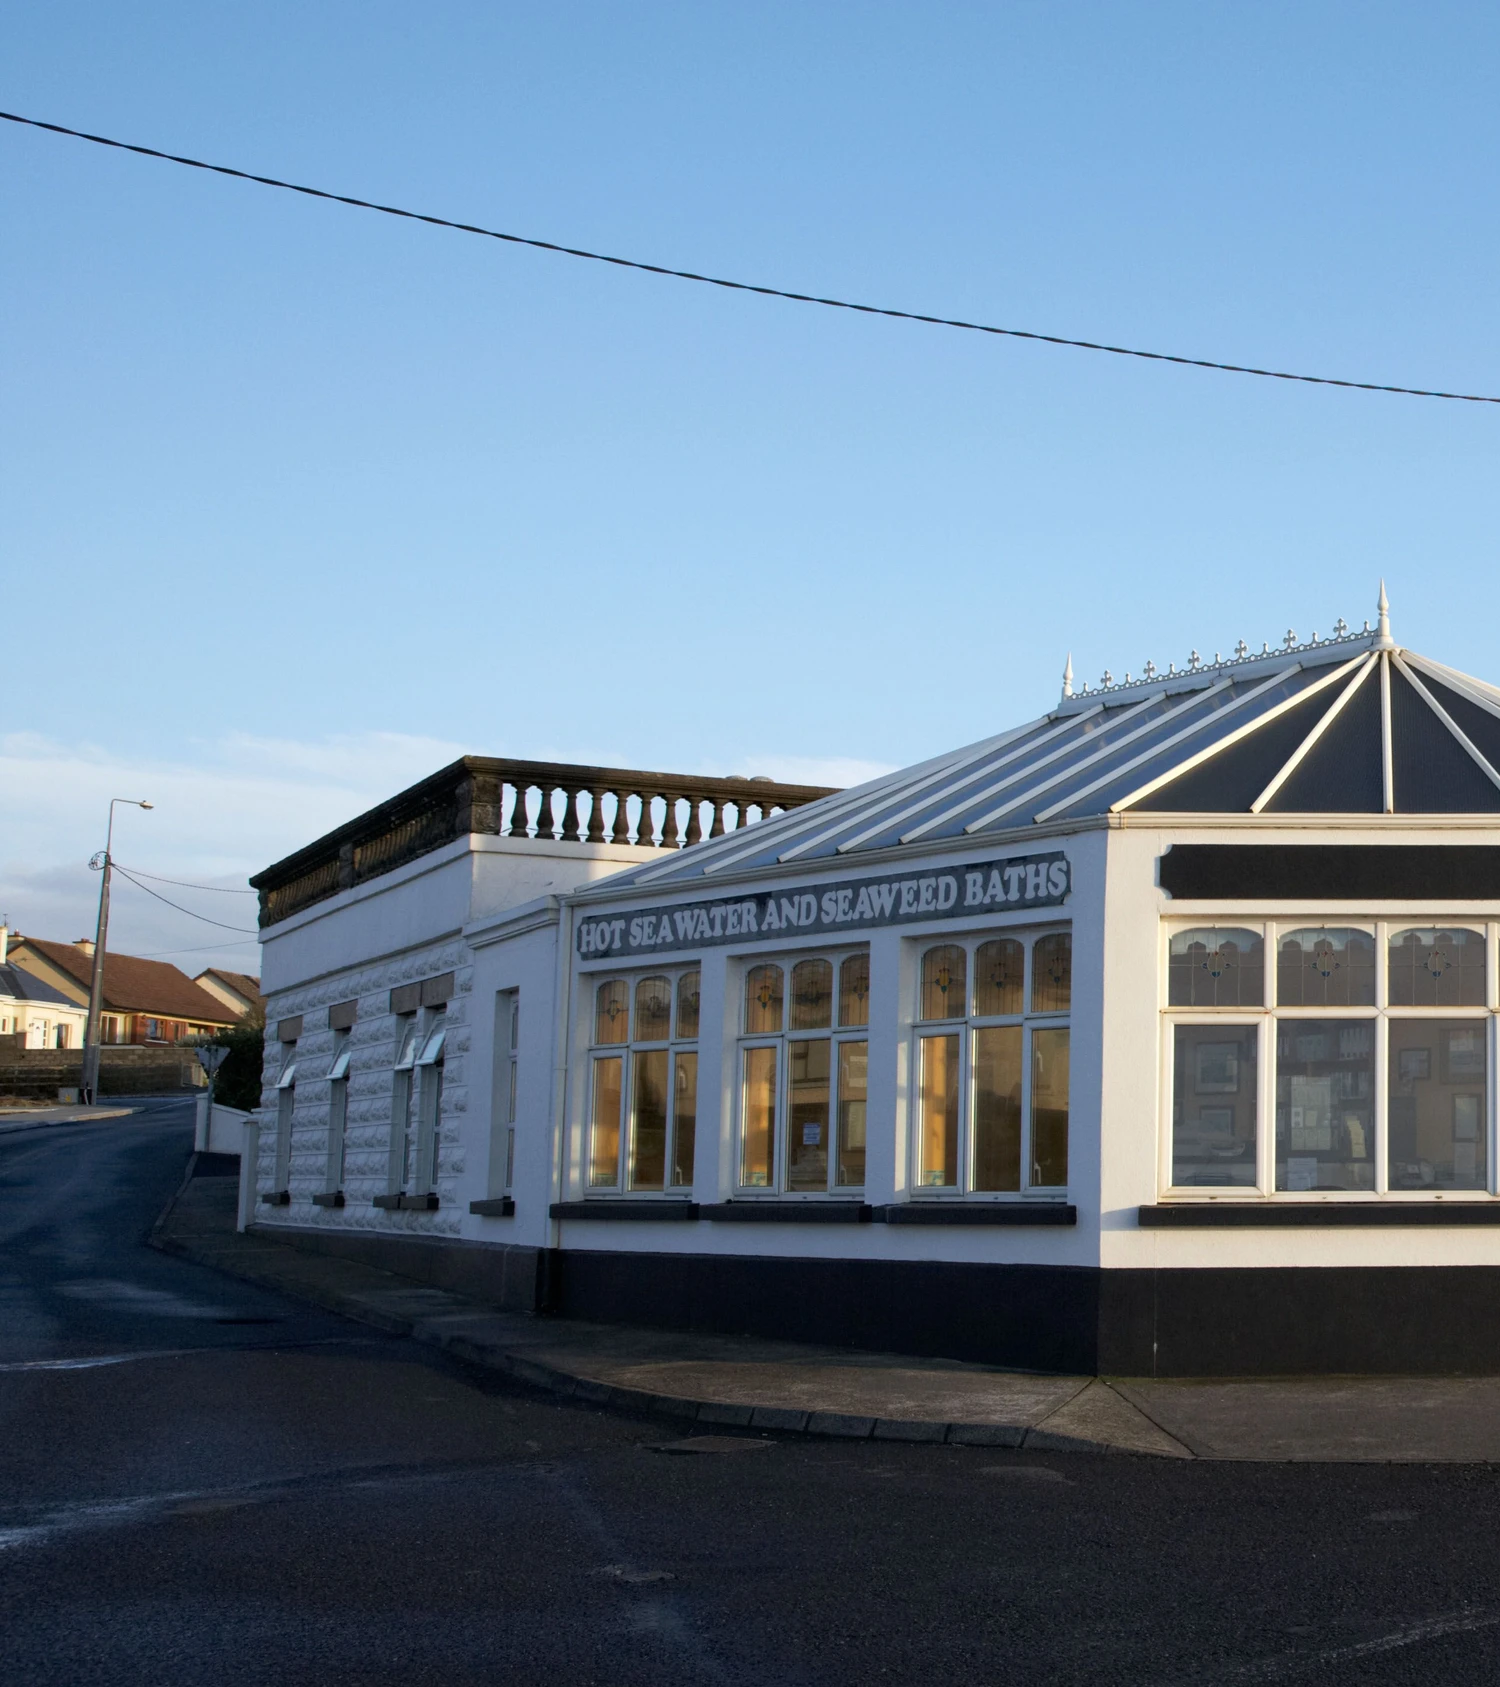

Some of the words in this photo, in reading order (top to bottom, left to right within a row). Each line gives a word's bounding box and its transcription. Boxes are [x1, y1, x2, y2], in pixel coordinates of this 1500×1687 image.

[580, 919, 625, 952] HOT
[762, 893, 818, 931] AND
[821, 875, 958, 924] SEAWEED
[964, 860, 1067, 906] BATHS
